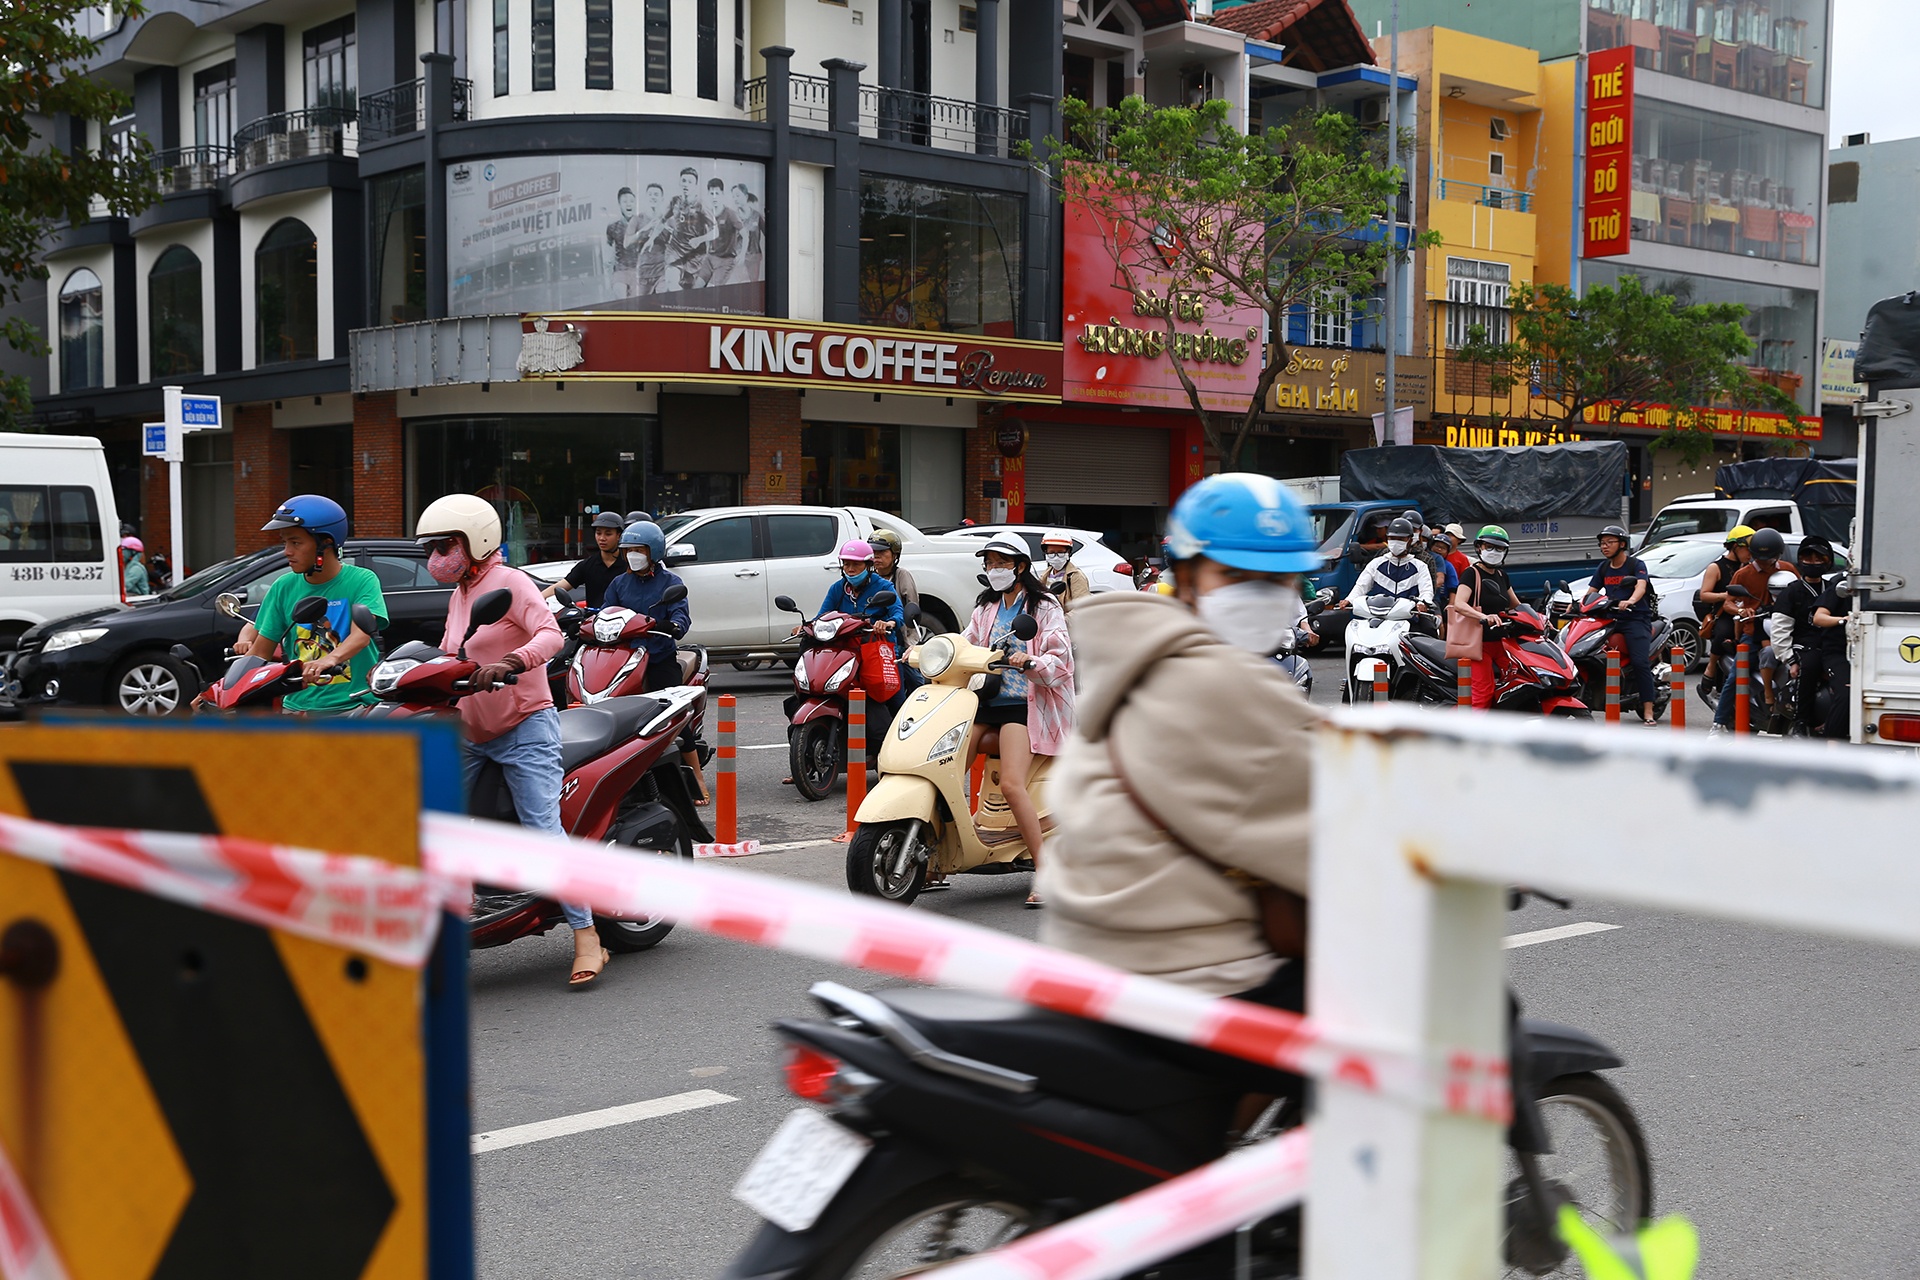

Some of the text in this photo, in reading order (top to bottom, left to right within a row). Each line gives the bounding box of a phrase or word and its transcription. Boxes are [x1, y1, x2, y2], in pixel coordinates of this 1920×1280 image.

[1592, 62, 1624, 99] THẾ
[1590, 114, 1623, 147] GIỚI
[493, 187, 514, 204] KING
[516, 176, 552, 197] COFFEE
[1594, 159, 1617, 194] ĐỒ
[522, 209, 553, 235] VIỆT
[556, 202, 592, 226] NAM
[1588, 208, 1621, 241] THỜ
[513, 234, 588, 257] KING COFFEE
[1077, 316, 1165, 359] HÙNG
[710, 326, 1048, 396] KING COFFEE Premium
[1285, 348, 1350, 380] Sàn gỗ
[1276, 383, 1310, 409] GIA
[1316, 381, 1359, 412] LÂM
[1446, 418, 1493, 449] BÁNH
[1750, 416, 1776, 435] PHONG
[769, 474, 782, 487] 87
[939, 755, 954, 766] SYM
